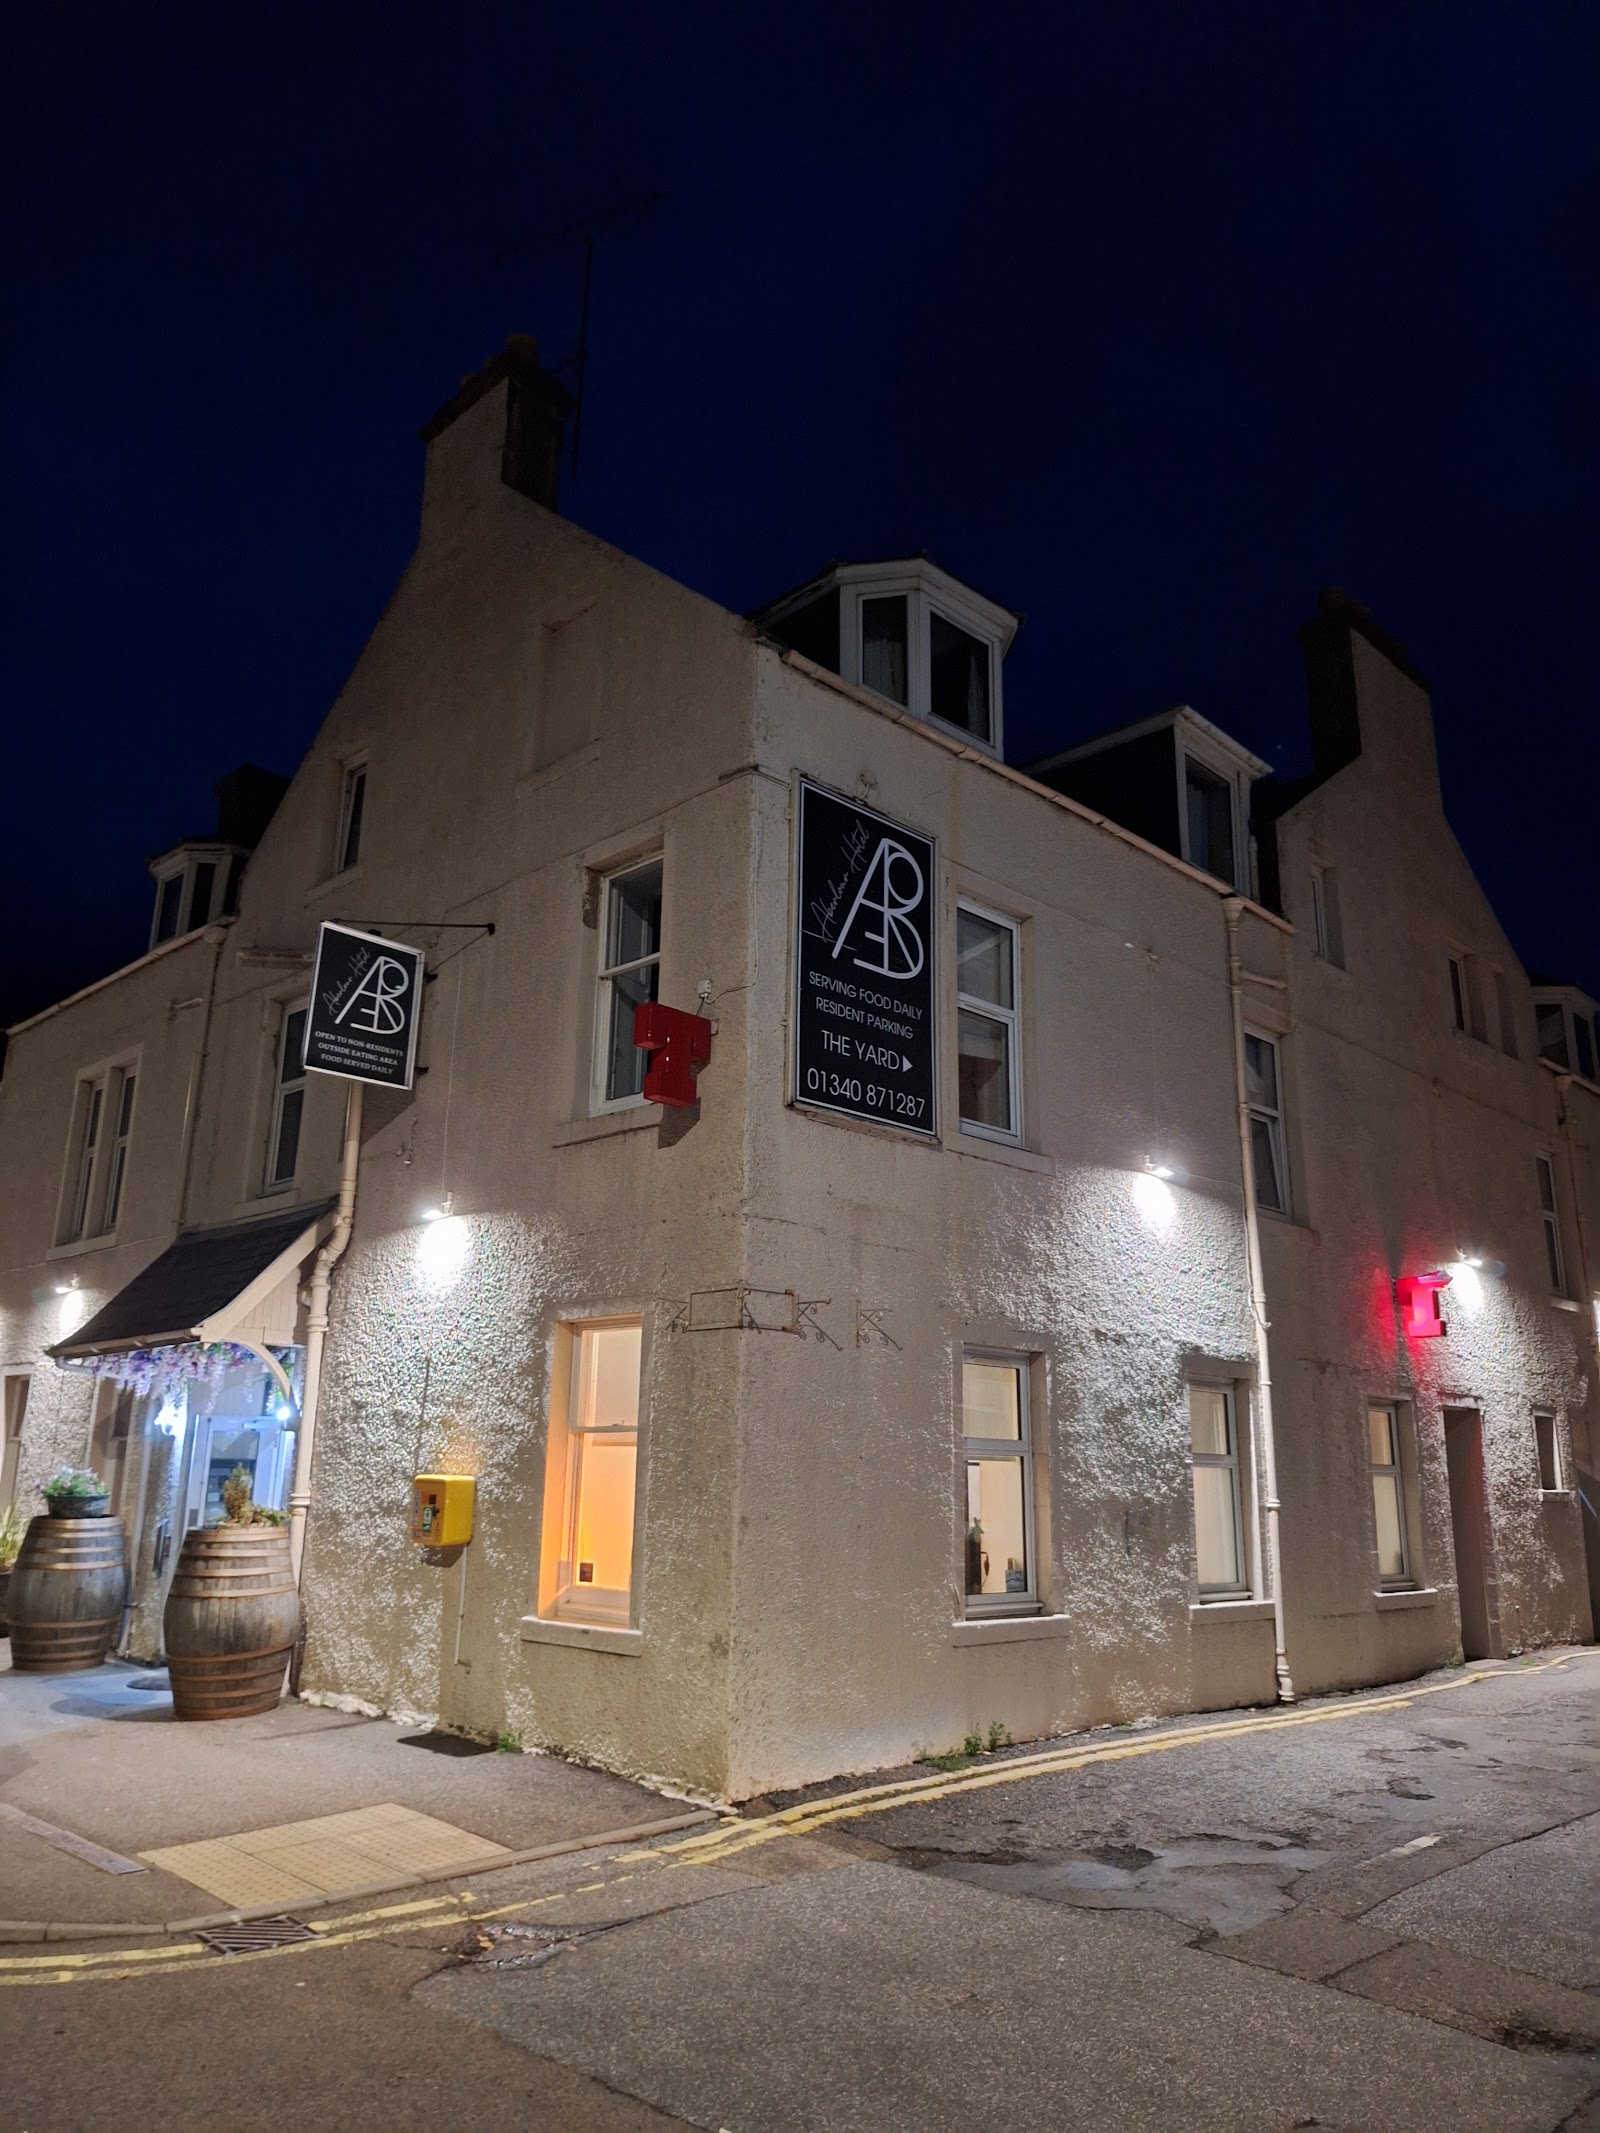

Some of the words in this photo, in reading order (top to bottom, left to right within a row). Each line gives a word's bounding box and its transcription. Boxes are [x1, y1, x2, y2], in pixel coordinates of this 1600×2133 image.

[809, 971, 857, 998] SERVING
[859, 988, 891, 1010] FOOD
[894, 999, 923, 1020] DAILY
[816, 996, 865, 1024] RESIDENT
[867, 1013, 914, 1039] PARKING
[315, 1030, 335, 1041] OPEN
[336, 1035, 347, 1044] TO
[348, 1038, 404, 1057] NON-RESIDENTS
[318, 1042, 350, 1055] OUTSIDE
[351, 1050, 378, 1061] EATING
[379, 1056, 398, 1066] AREA
[321, 1053, 342, 1063] FOOD
[343, 1058, 371, 1070] SERVED
[371, 1064, 394, 1075] DAILY
[821, 1029, 851, 1057] THE
[854, 1039, 900, 1070] YARD
[807, 1067, 862, 1102] 01340
[866, 1084, 926, 1118] 871287
